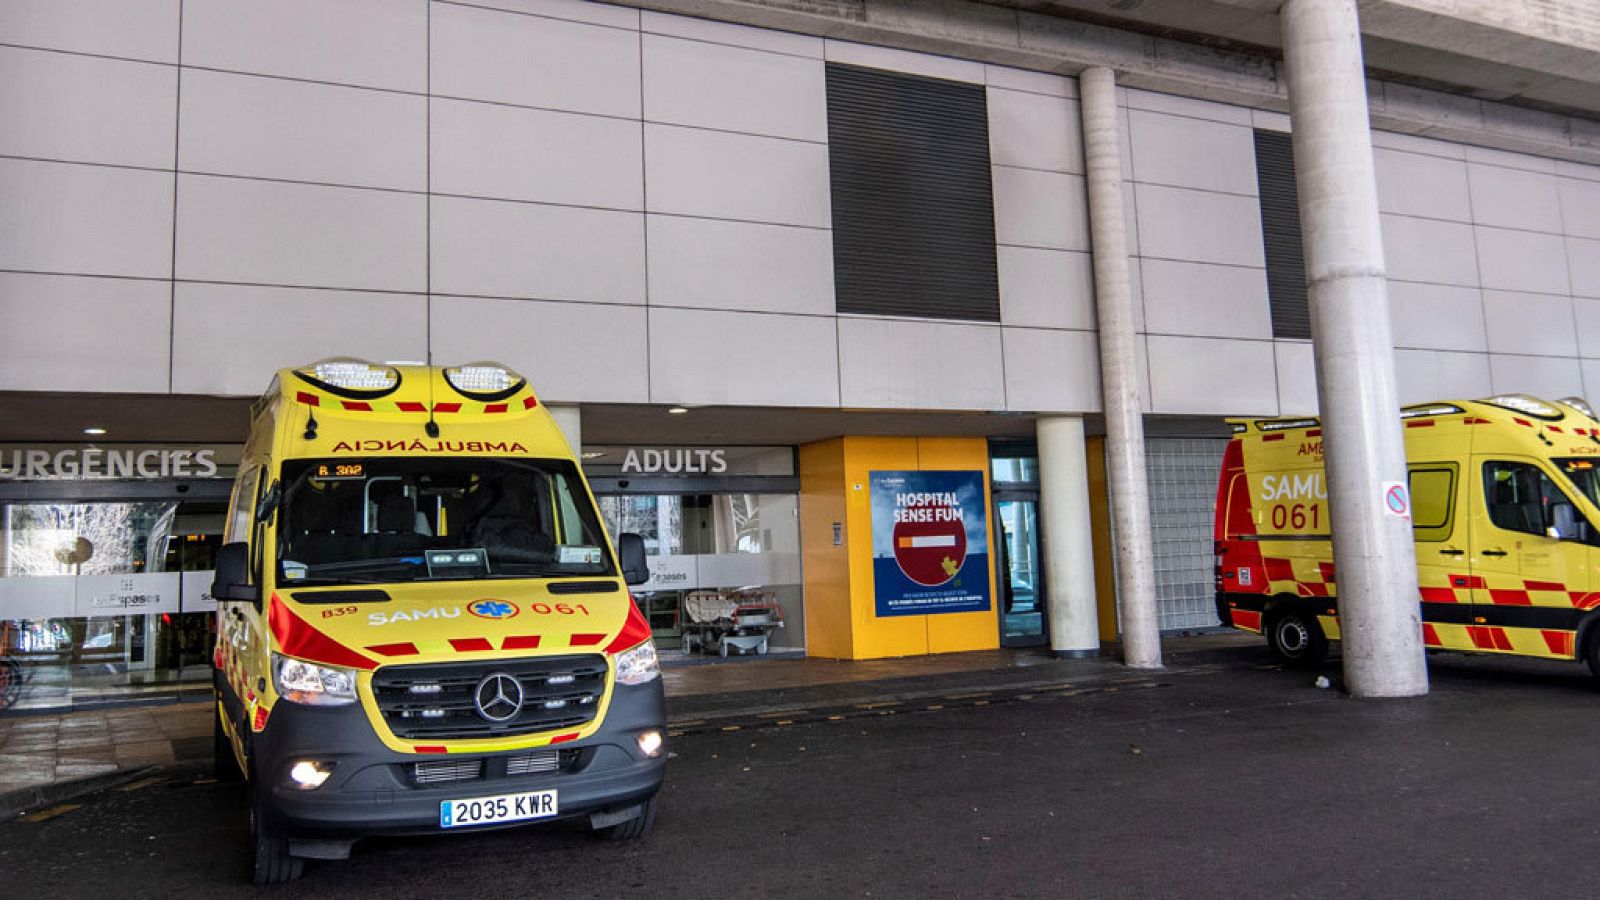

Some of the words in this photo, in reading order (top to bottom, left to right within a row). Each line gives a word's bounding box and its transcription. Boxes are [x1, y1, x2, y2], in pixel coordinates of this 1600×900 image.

[0, 444, 218, 477] URGÈNCIES
[622, 449, 727, 473] ADULTS
[896, 492, 960, 507] HOSPITAL
[1262, 474, 1328, 500] SAMU
[894, 508, 933, 522] SENSE
[935, 508, 964, 521] FUM
[1271, 503, 1318, 529] 061
[367, 607, 461, 626] SAMU
[530, 602, 590, 616] 061
[456, 799, 508, 823] 2035
[515, 794, 553, 816] KWR
